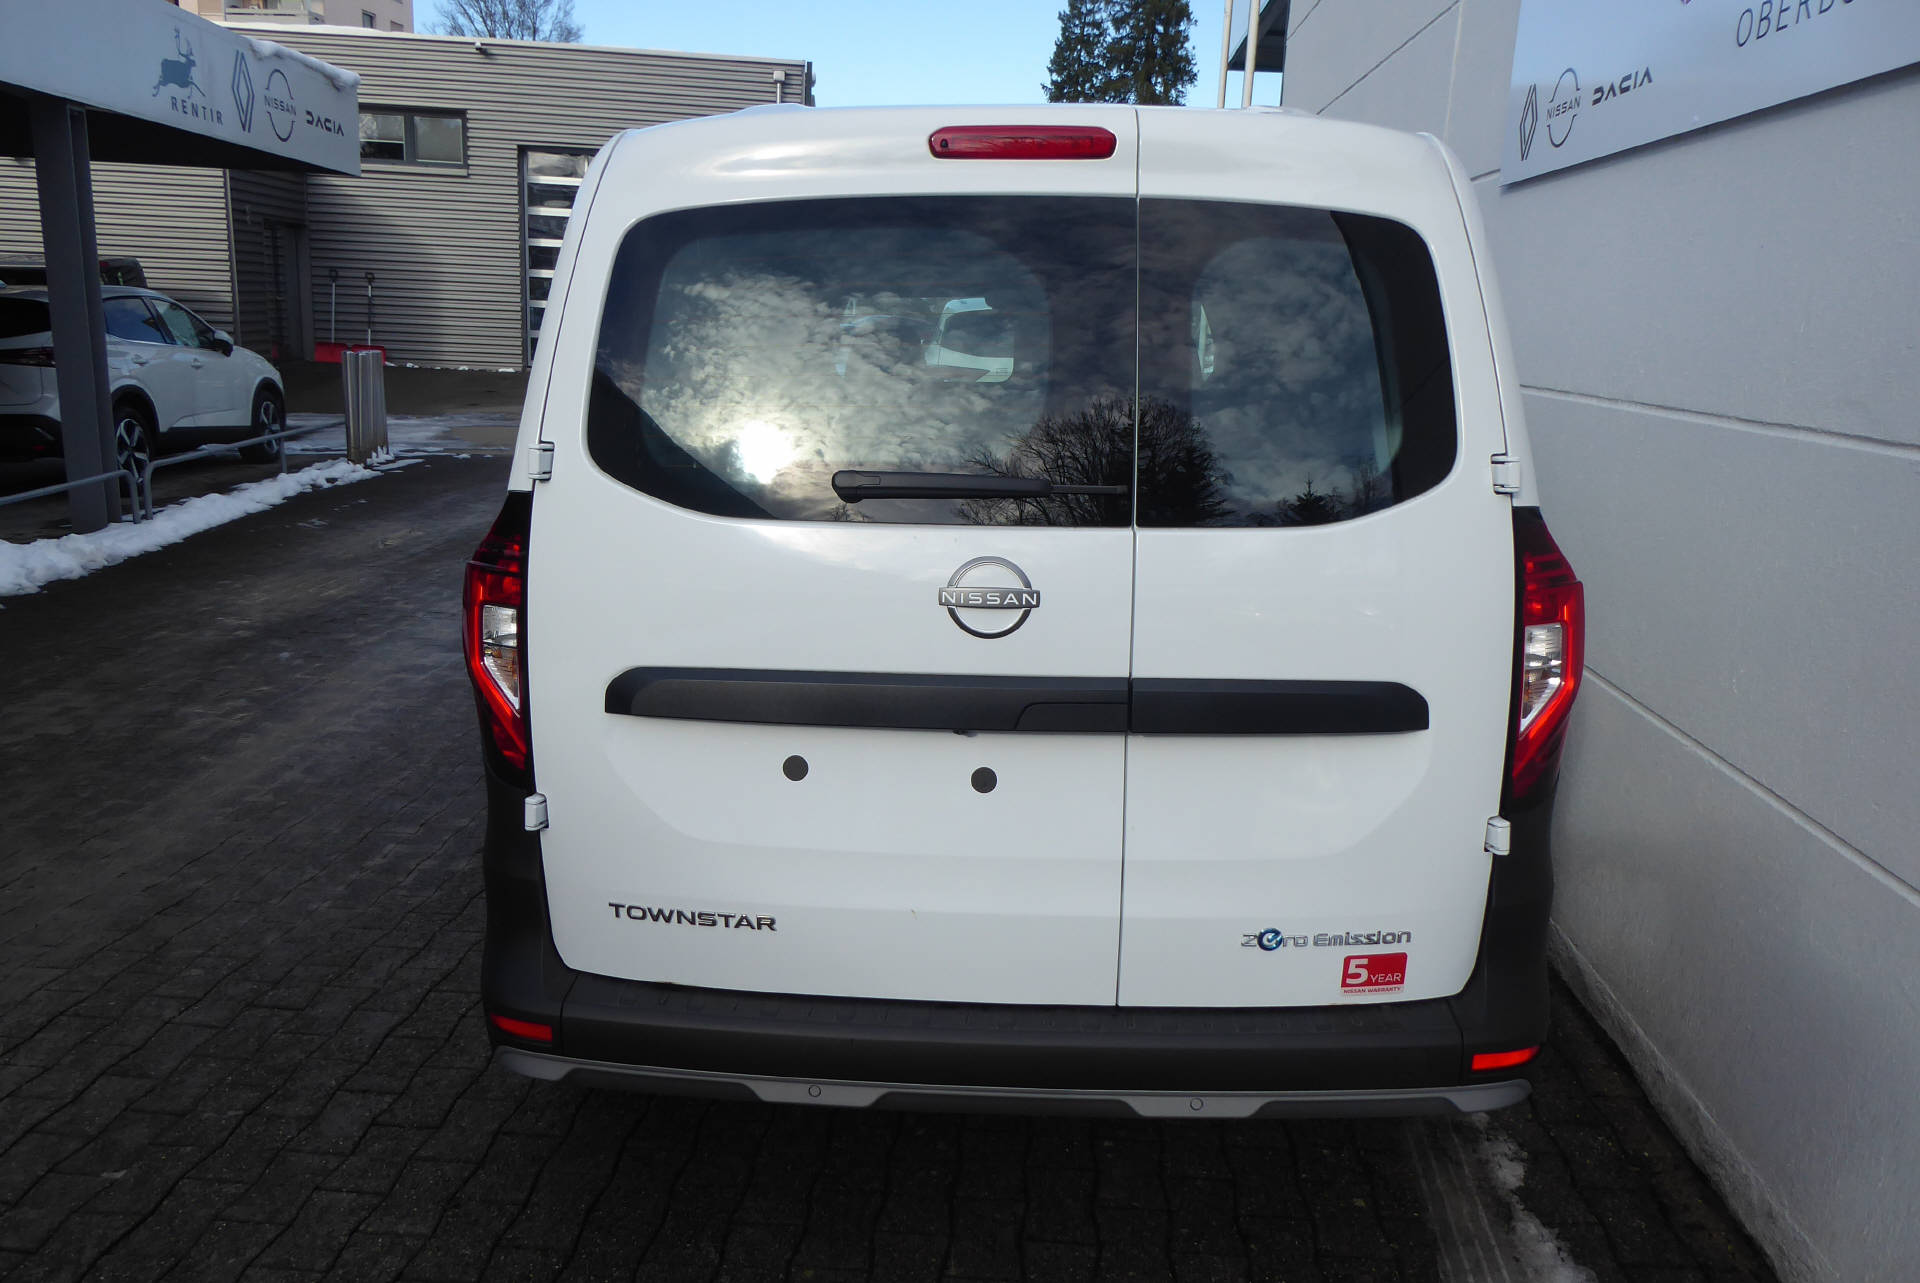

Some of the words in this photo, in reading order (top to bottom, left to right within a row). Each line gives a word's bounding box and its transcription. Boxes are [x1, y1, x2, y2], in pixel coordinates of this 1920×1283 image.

[1592, 66, 1653, 106] DACIA
[170, 96, 223, 126] RENTIR
[264, 94, 296, 117] NISSAN
[1546, 95, 1581, 121] NISSAN
[306, 110, 345, 137] DACIA
[941, 591, 1037, 606] NISSAN
[608, 901, 778, 932] TOWNSTAR
[1313, 930, 1412, 948] Emission
[1345, 958, 1369, 985] 5
[1369, 972, 1402, 984] YEAR
